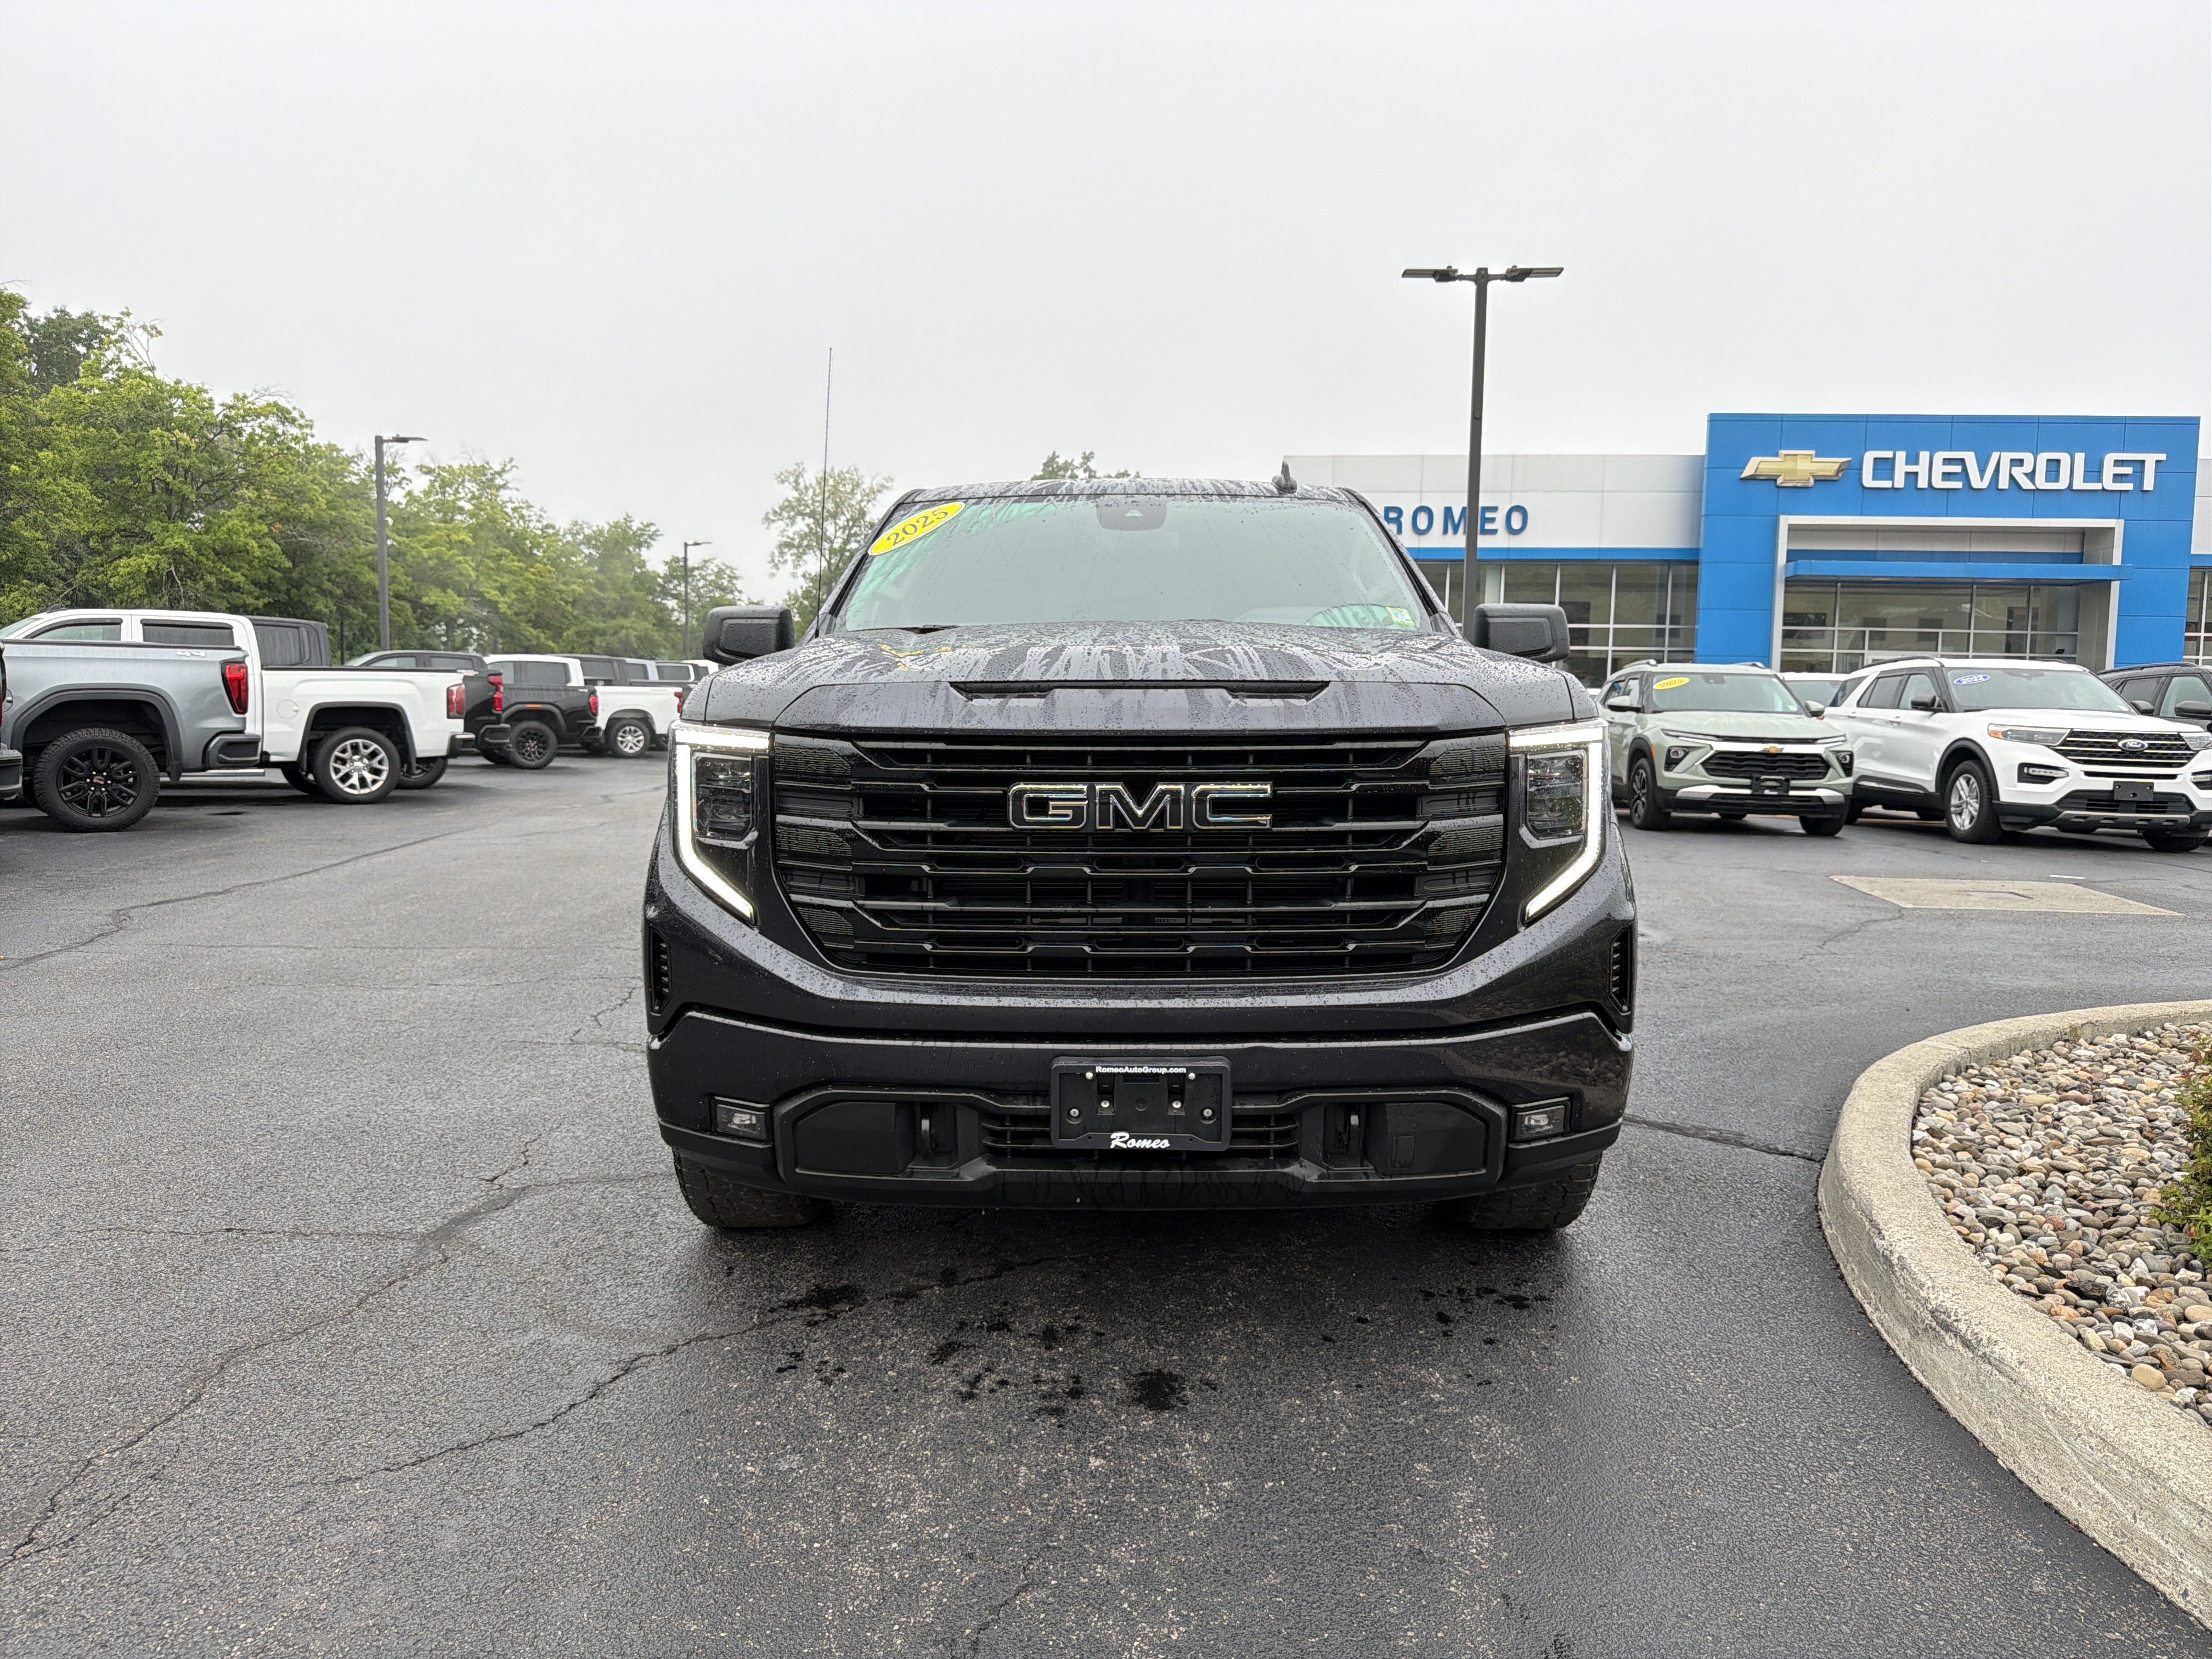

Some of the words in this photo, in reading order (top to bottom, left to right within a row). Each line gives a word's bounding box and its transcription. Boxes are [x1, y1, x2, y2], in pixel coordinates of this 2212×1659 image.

[1862, 450, 2166, 492] CHEVROLET
[887, 508, 949, 546] 2025
[1384, 505, 1528, 535] ROMEO
[1960, 674, 1983, 684] 2022
[1007, 781, 1273, 831] GMC
[1095, 1065, 1187, 1074] RomeoAutoGroup.com
[1110, 1131, 1170, 1149] Romeo
